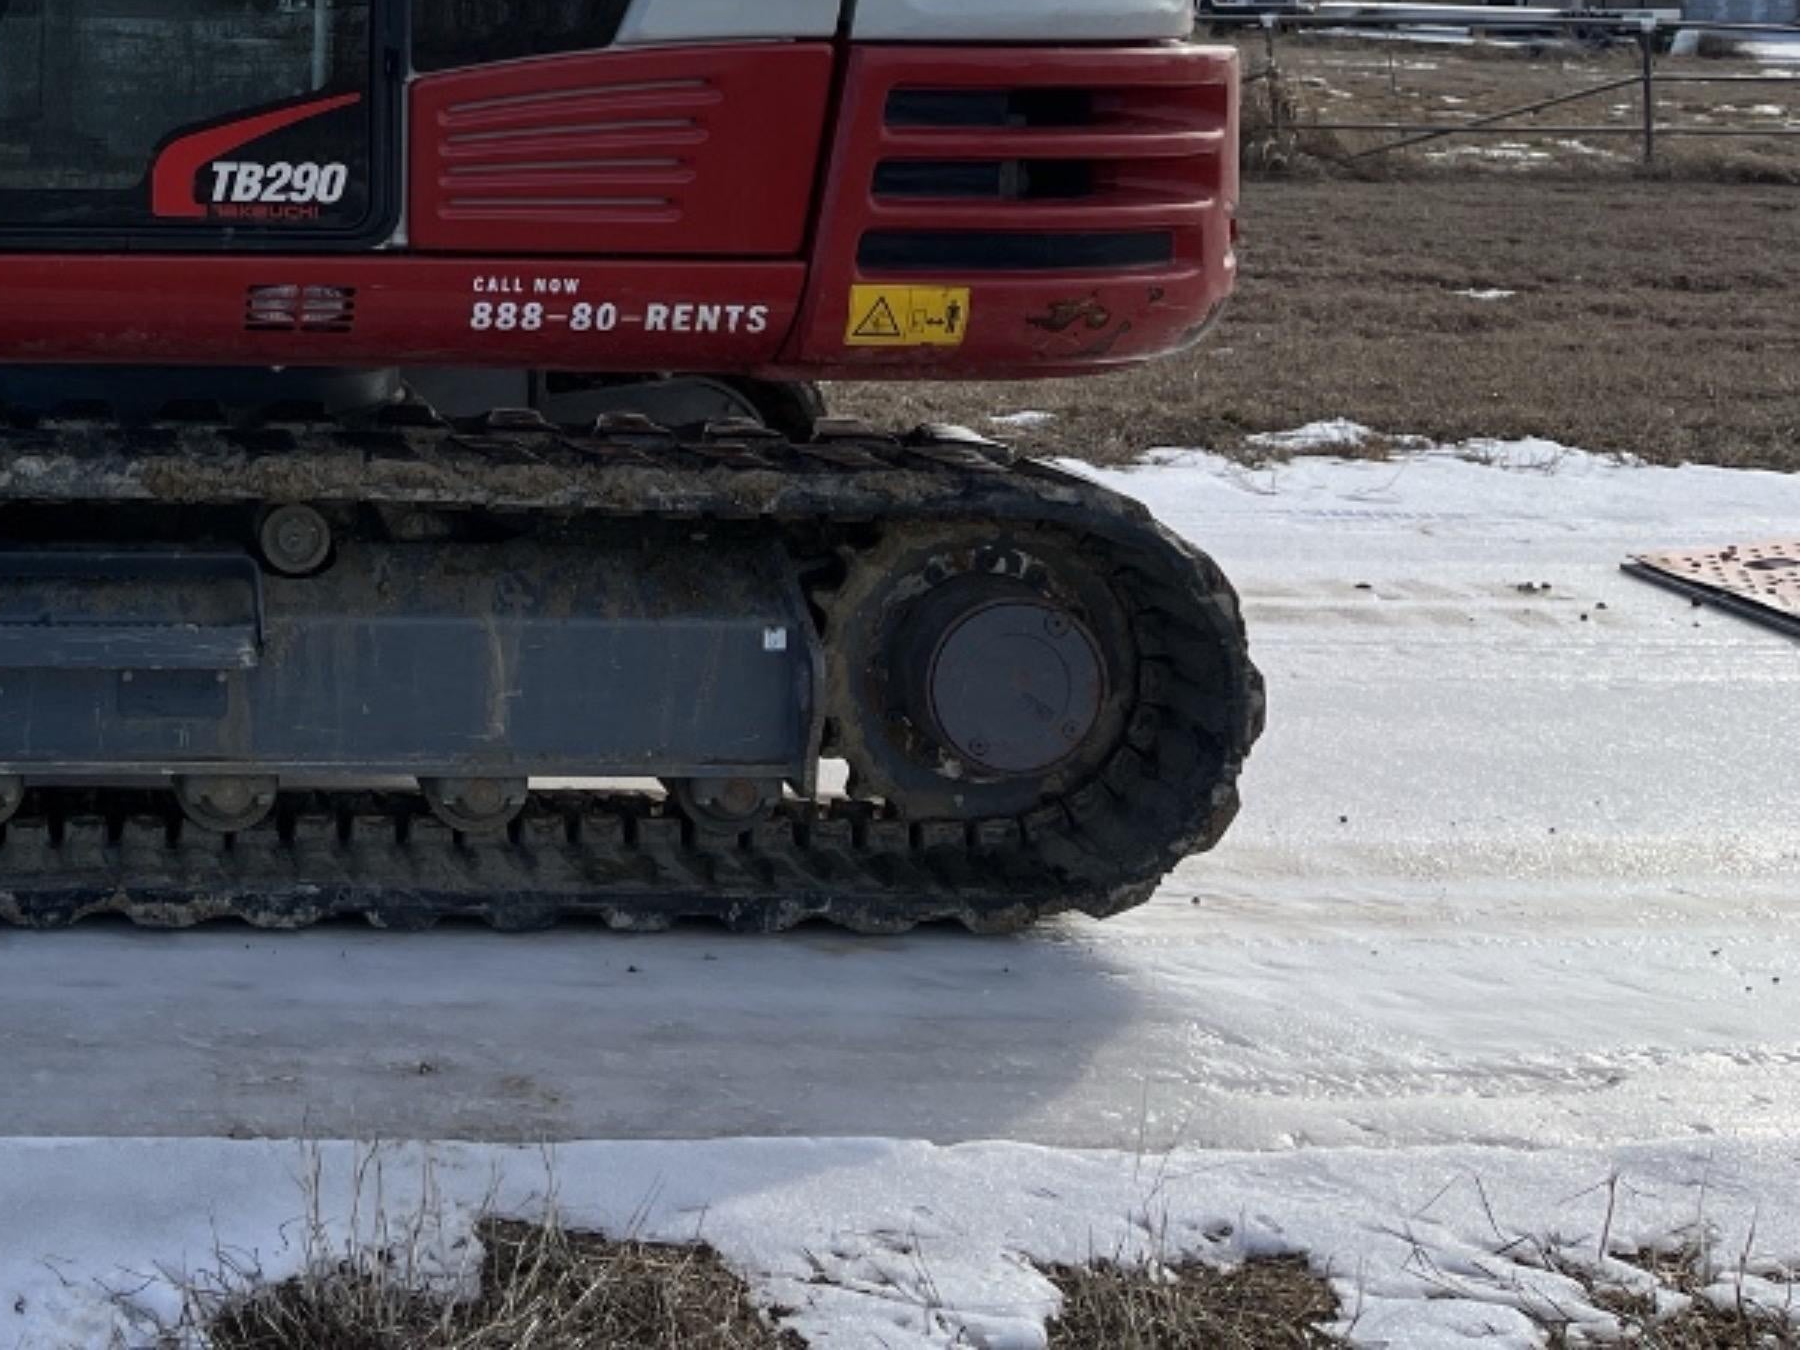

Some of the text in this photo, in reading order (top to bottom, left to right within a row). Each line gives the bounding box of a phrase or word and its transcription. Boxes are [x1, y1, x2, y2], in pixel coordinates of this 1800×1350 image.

[211, 161, 348, 204] TB290
[472, 276, 580, 294] CALL NOW
[470, 302, 769, 333] 888-80-RENTS
